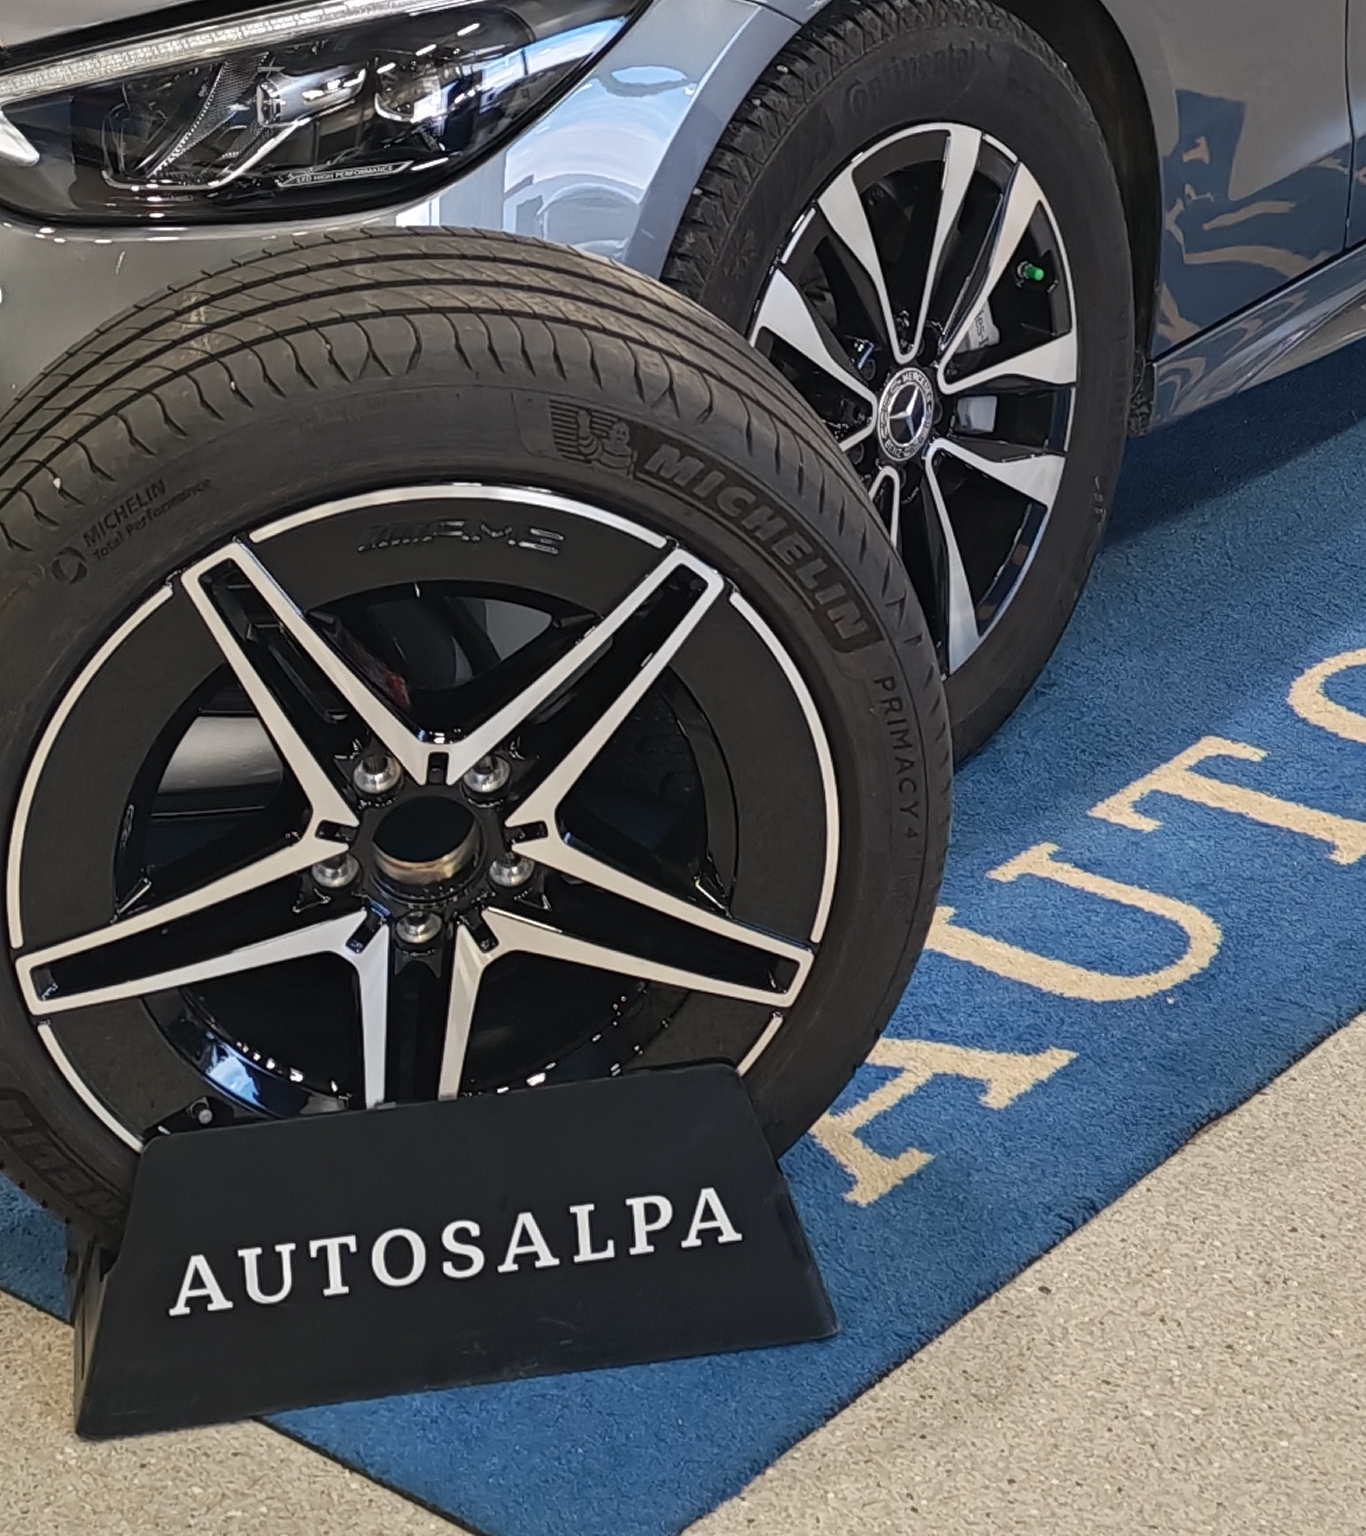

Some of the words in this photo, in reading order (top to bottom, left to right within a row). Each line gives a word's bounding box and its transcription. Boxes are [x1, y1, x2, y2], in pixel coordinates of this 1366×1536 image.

[82, 477, 167, 548] MICHELIN
[642, 443, 871, 641] MICHELIN
[872, 675, 920, 819] PRIMACY
[905, 826, 919, 839] 4
[168, 1185, 743, 1318] AUTOSALPA
